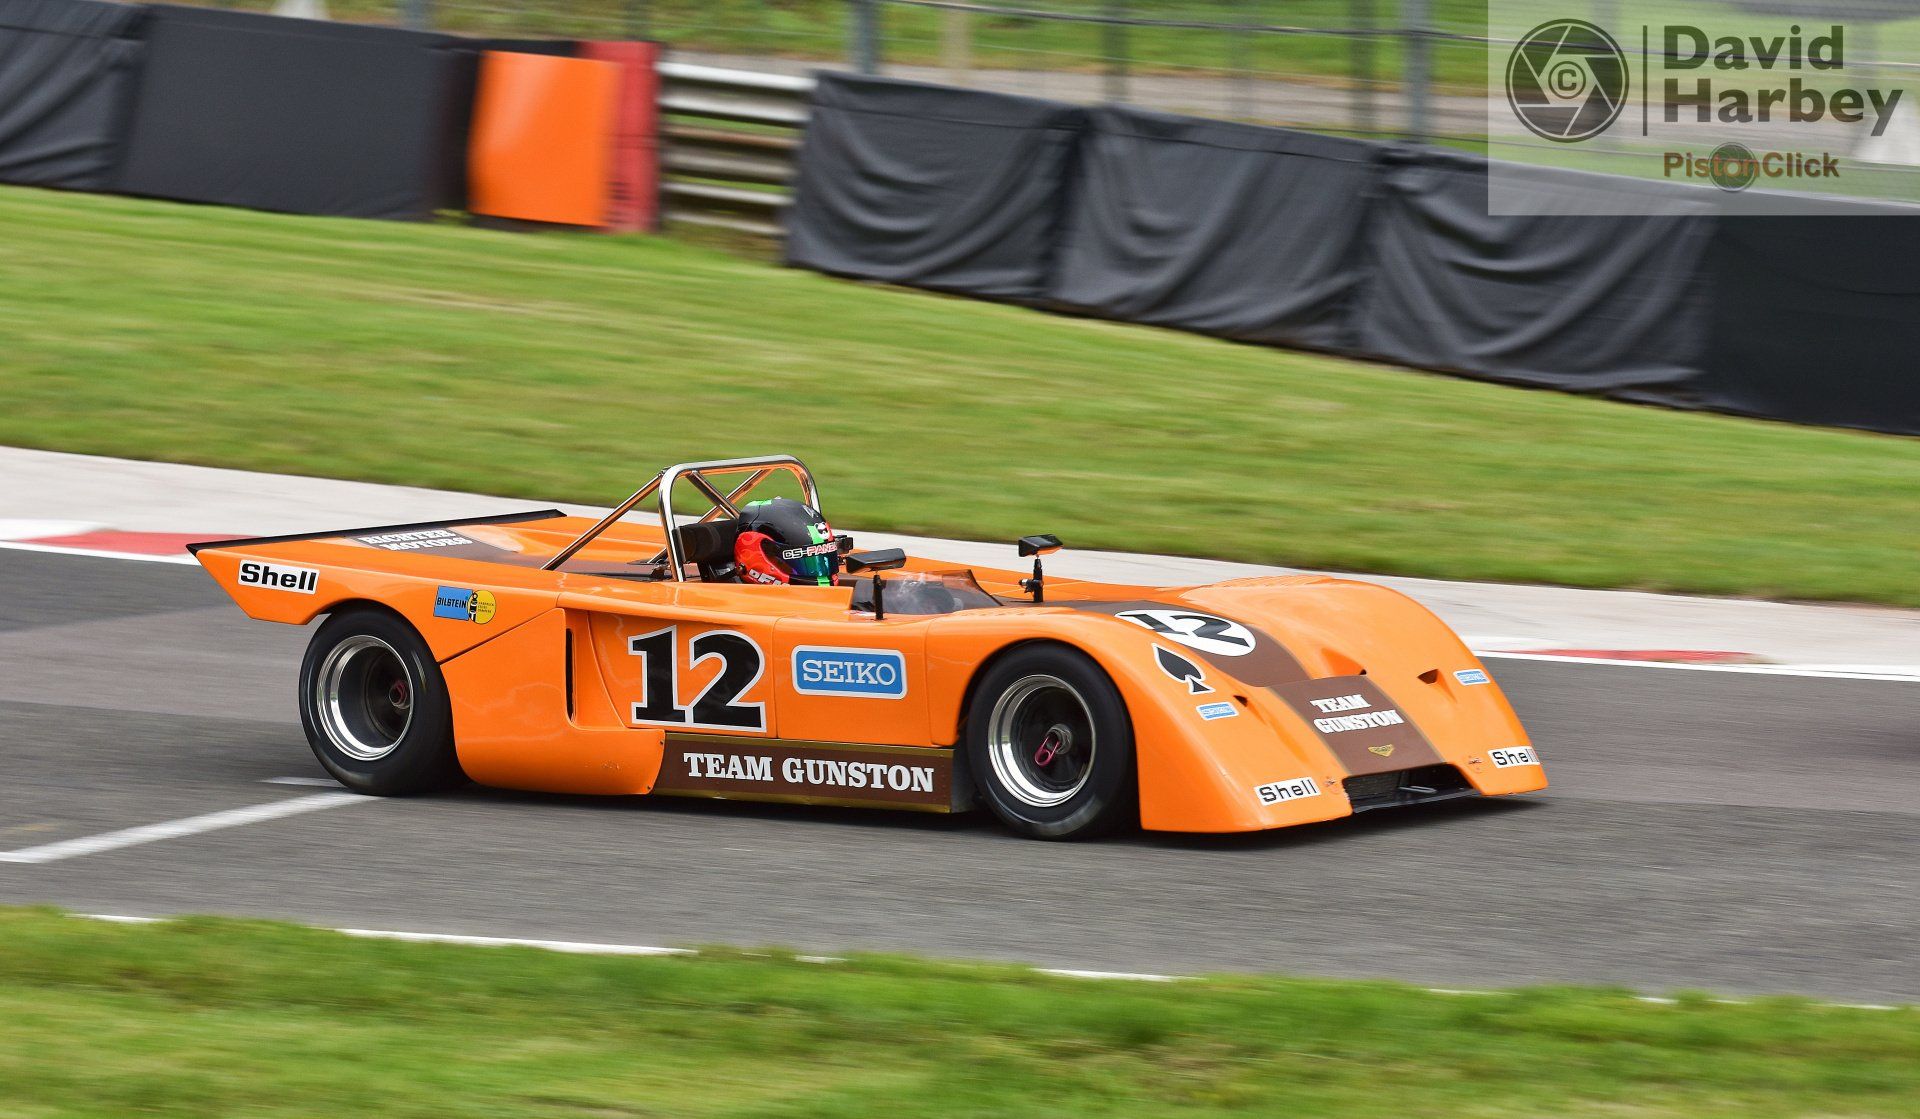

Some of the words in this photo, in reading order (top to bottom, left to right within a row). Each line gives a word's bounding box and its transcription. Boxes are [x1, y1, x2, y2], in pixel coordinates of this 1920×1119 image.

[379, 537, 473, 550] MOTORS
[240, 562, 317, 591] Shell
[436, 597, 467, 609] BILSTEIN
[1117, 613, 1251, 648] 12
[628, 624, 767, 732] 12
[802, 659, 897, 686] SEIKO
[1310, 694, 1371, 713] TEAM
[1313, 709, 1405, 734] GUNSTON
[683, 752, 774, 782] TEAM
[1491, 748, 1539, 766] Shell
[782, 757, 935, 793] GUNSTON
[1258, 778, 1318, 803] Shell
